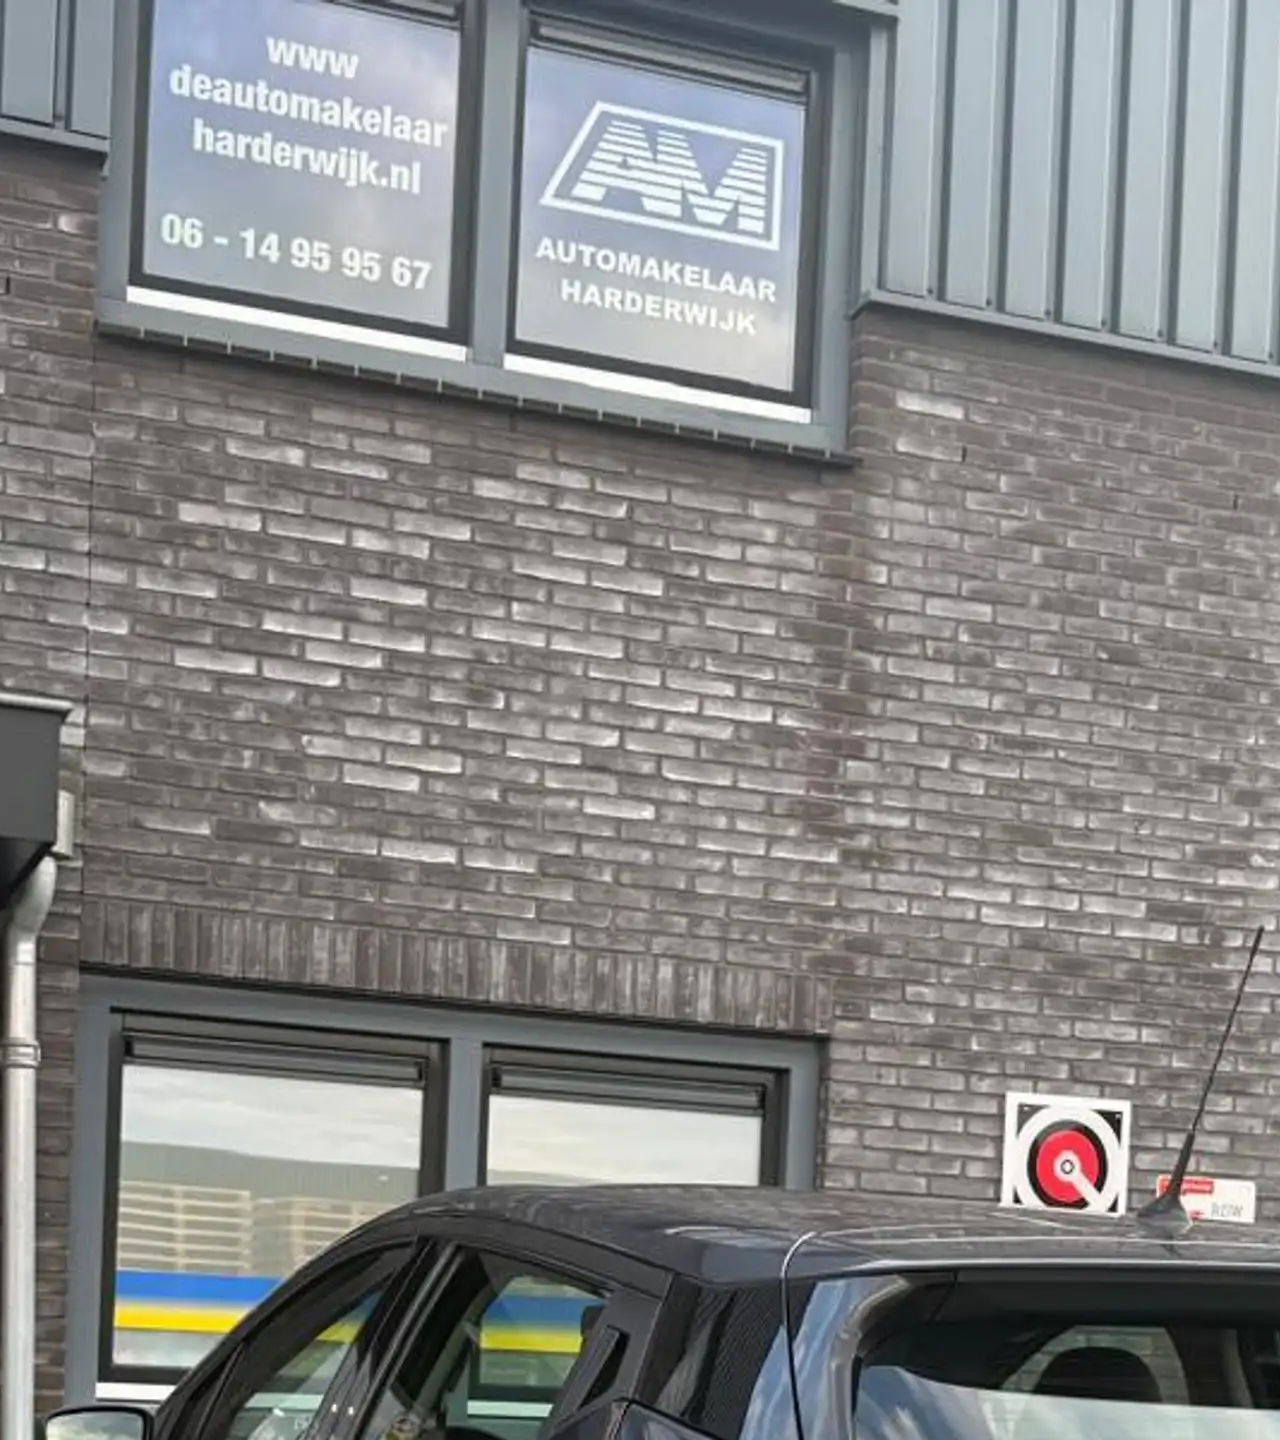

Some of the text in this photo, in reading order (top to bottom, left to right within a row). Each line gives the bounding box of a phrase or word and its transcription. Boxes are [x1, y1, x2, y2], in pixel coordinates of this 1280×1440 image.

[266, 36, 359, 79] www
[169, 63, 449, 147] deautomakelaar
[192, 117, 422, 194] harderwijk.nl
[160, 213, 204, 249] 06
[239, 227, 281, 263] 14
[290, 236, 332, 272] 95
[341, 246, 382, 281] 95
[391, 255, 433, 289] 67
[535, 236, 777, 304] AUTOMAKELAAR
[560, 277, 757, 336] HARDERWIJK
